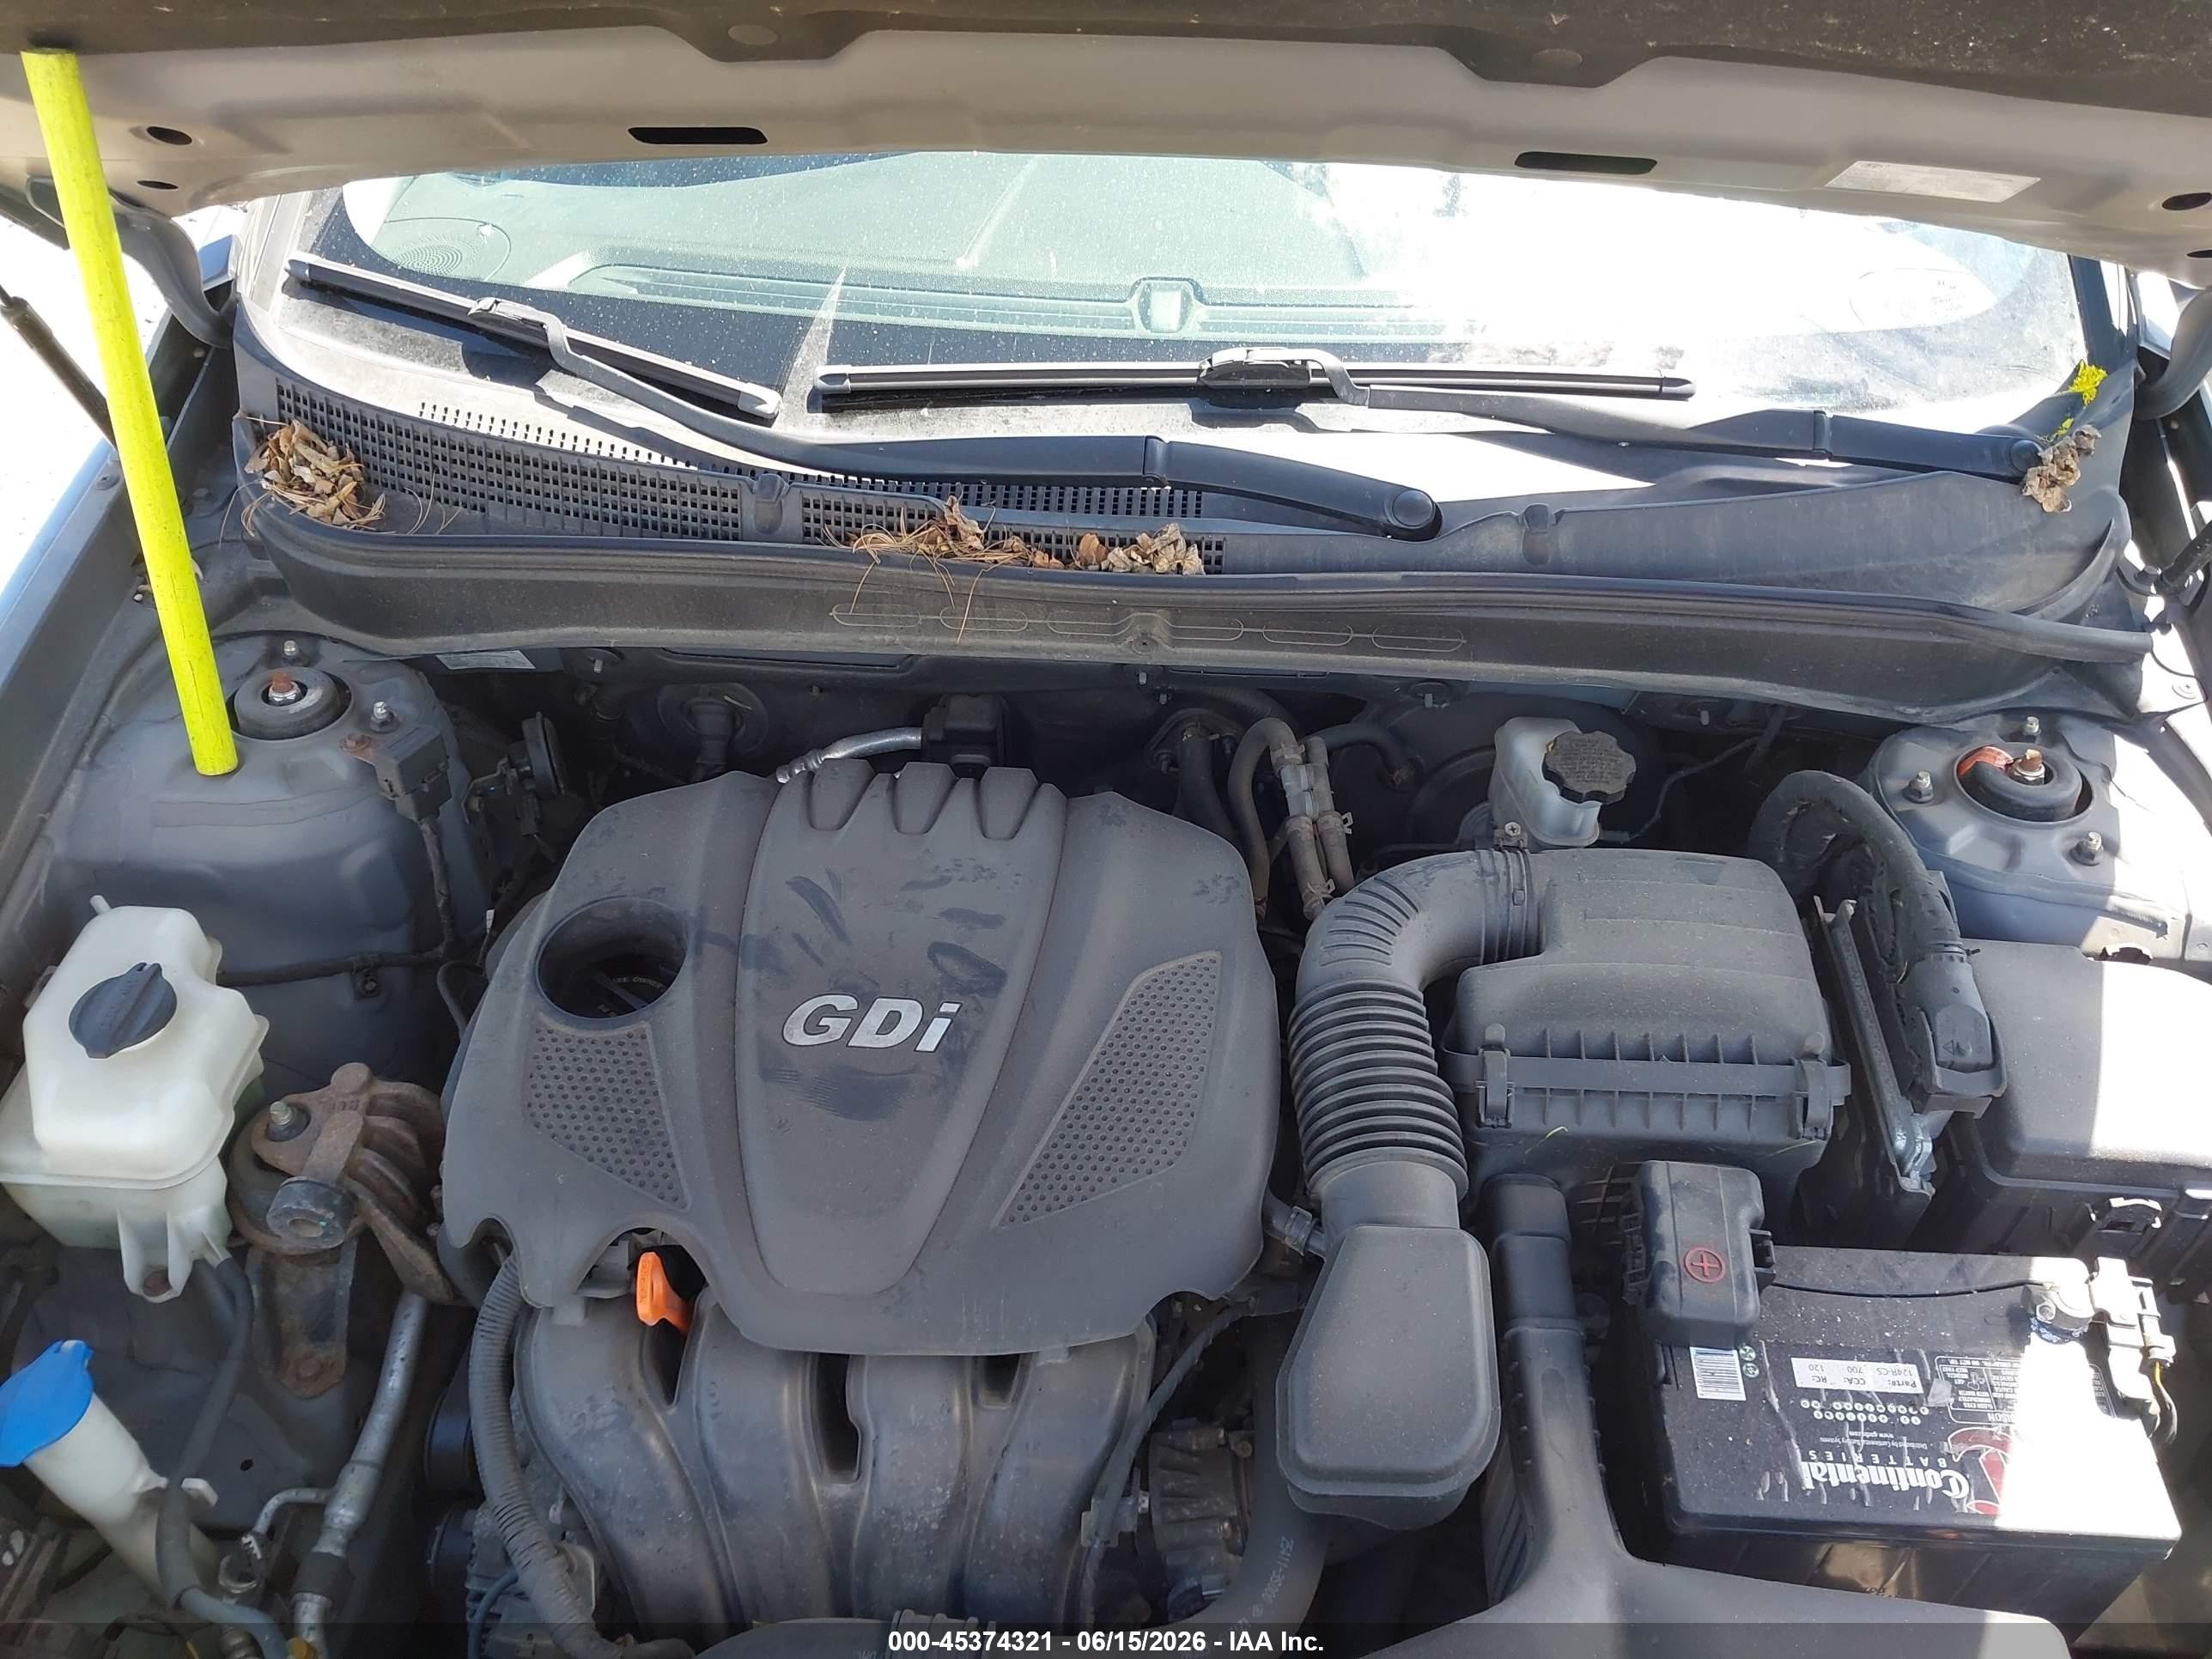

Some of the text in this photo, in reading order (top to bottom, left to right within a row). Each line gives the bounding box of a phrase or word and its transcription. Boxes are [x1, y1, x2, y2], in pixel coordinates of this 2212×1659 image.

[782, 994, 962, 1053] GDi
[1808, 1364, 1824, 1372] 120
[1846, 1365, 1865, 1374] 700
[1808, 1450, 1948, 1468] BATTERIES
[1800, 1462, 1970, 1499] Continental
